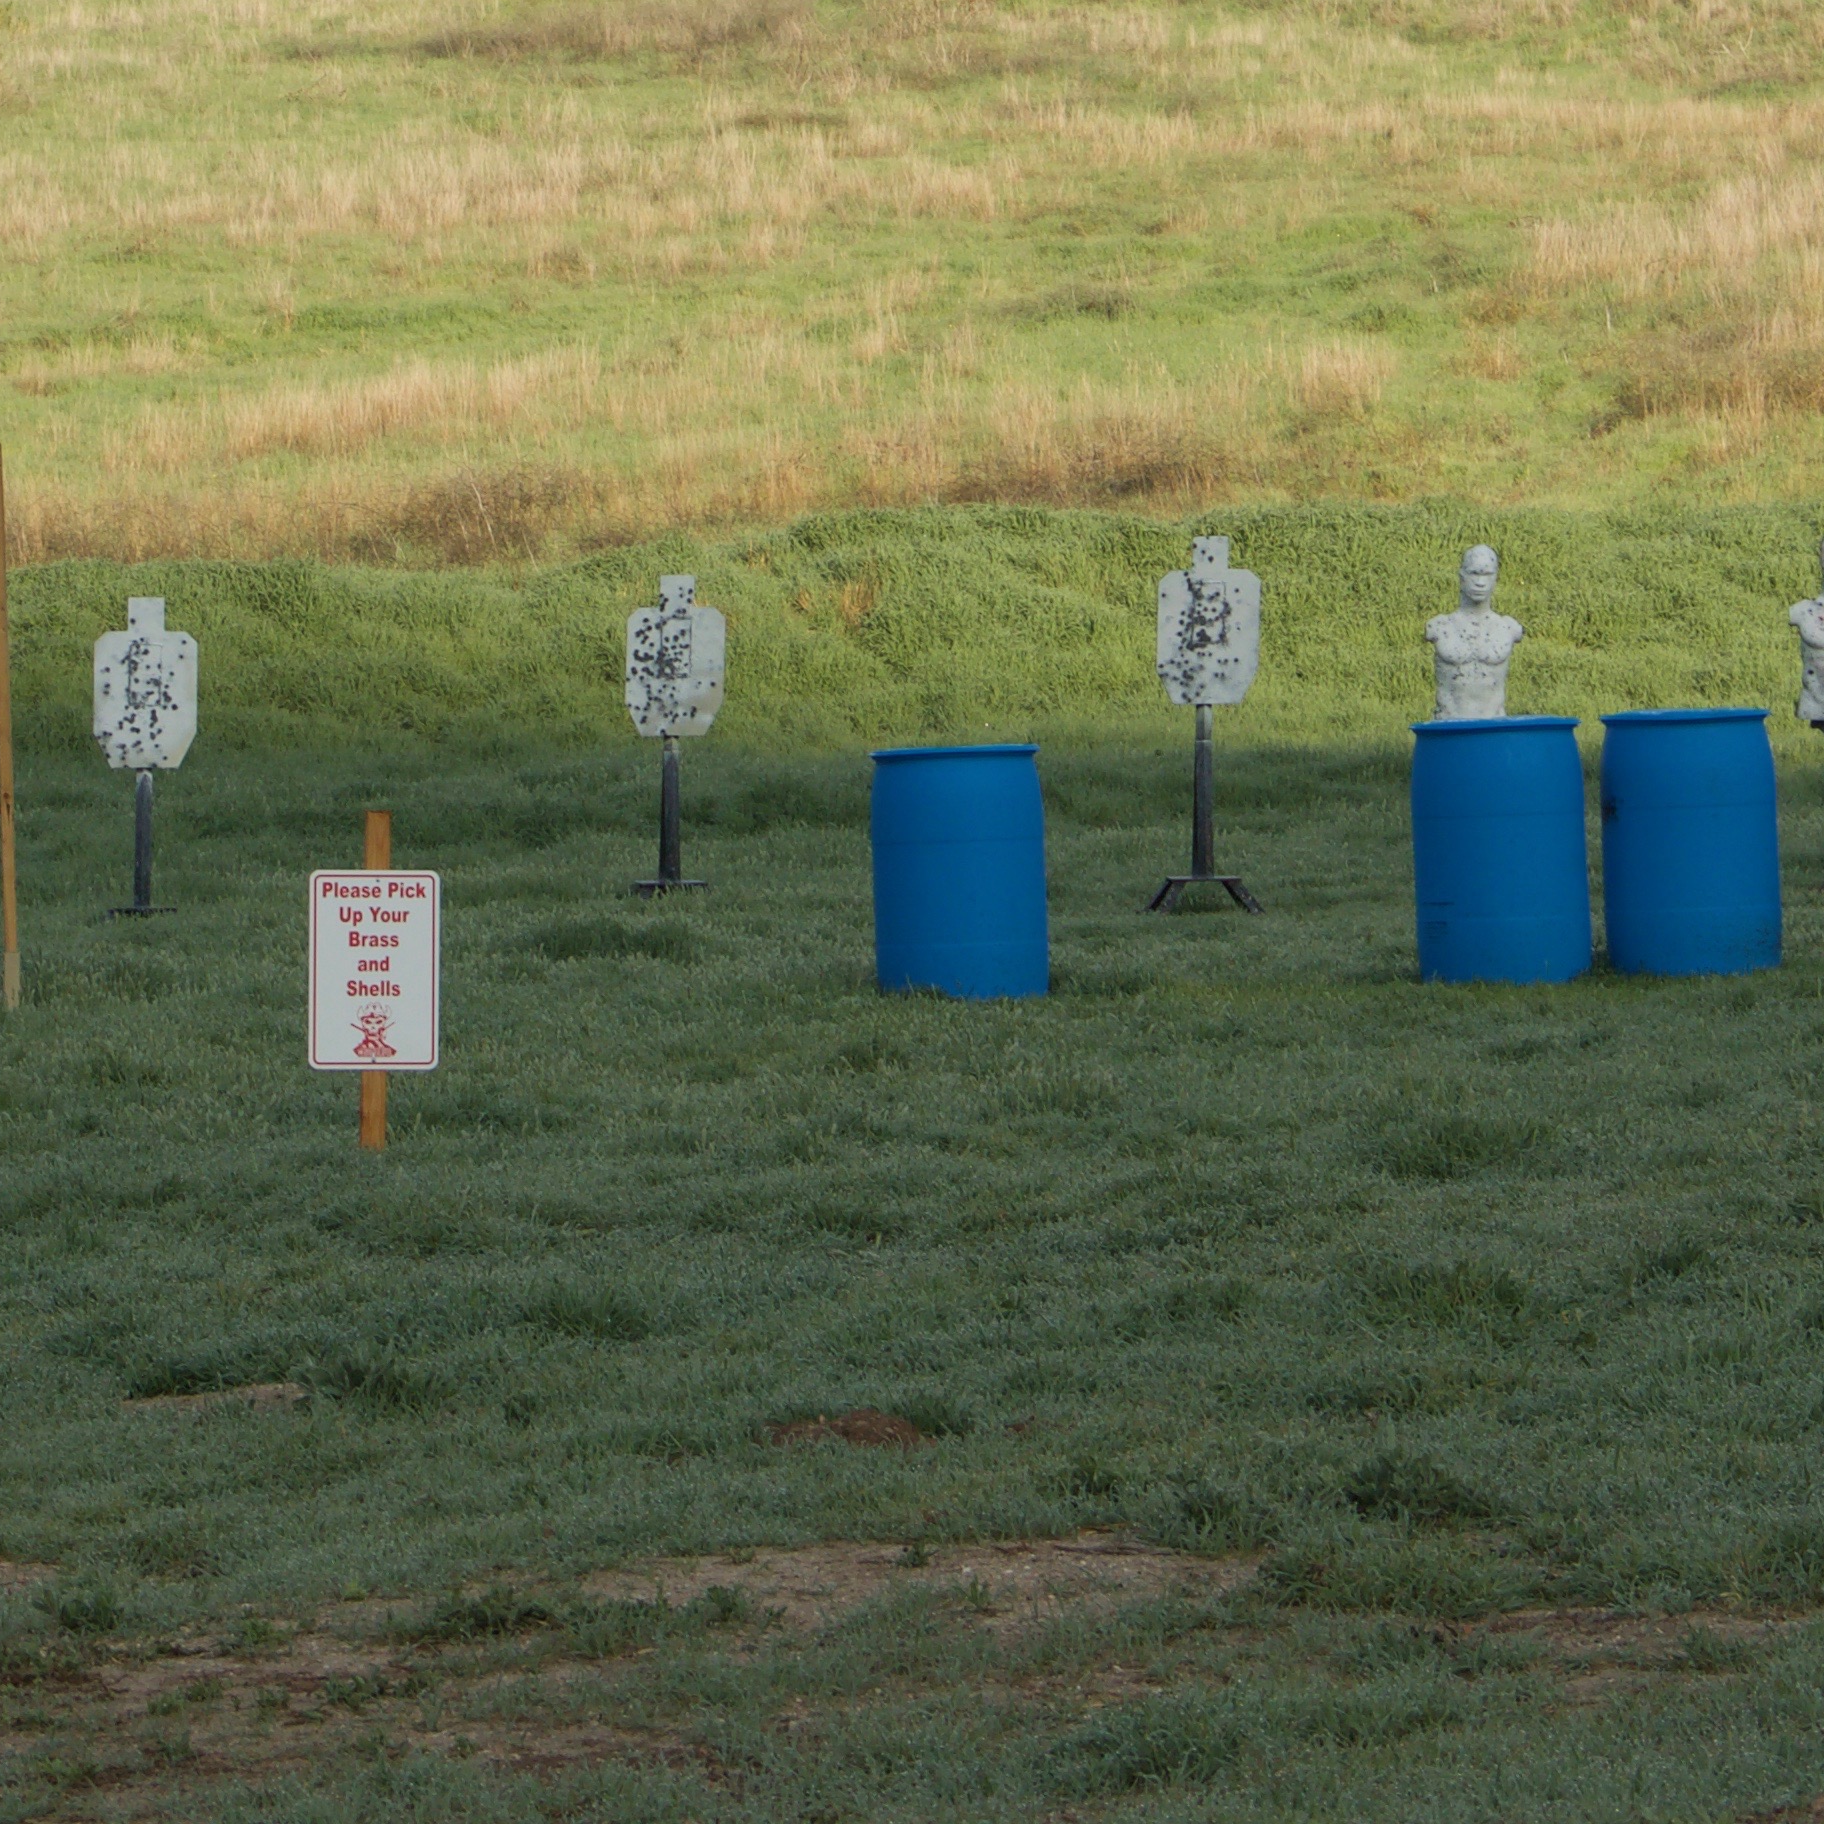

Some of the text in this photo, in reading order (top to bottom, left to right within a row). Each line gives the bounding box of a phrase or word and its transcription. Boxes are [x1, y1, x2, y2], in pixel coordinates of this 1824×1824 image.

[322, 882, 426, 898] Please Pick
[339, 907, 409, 925] Up Your
[348, 931, 399, 947] Brass
[357, 956, 390, 972] and
[346, 980, 401, 997] Shells
